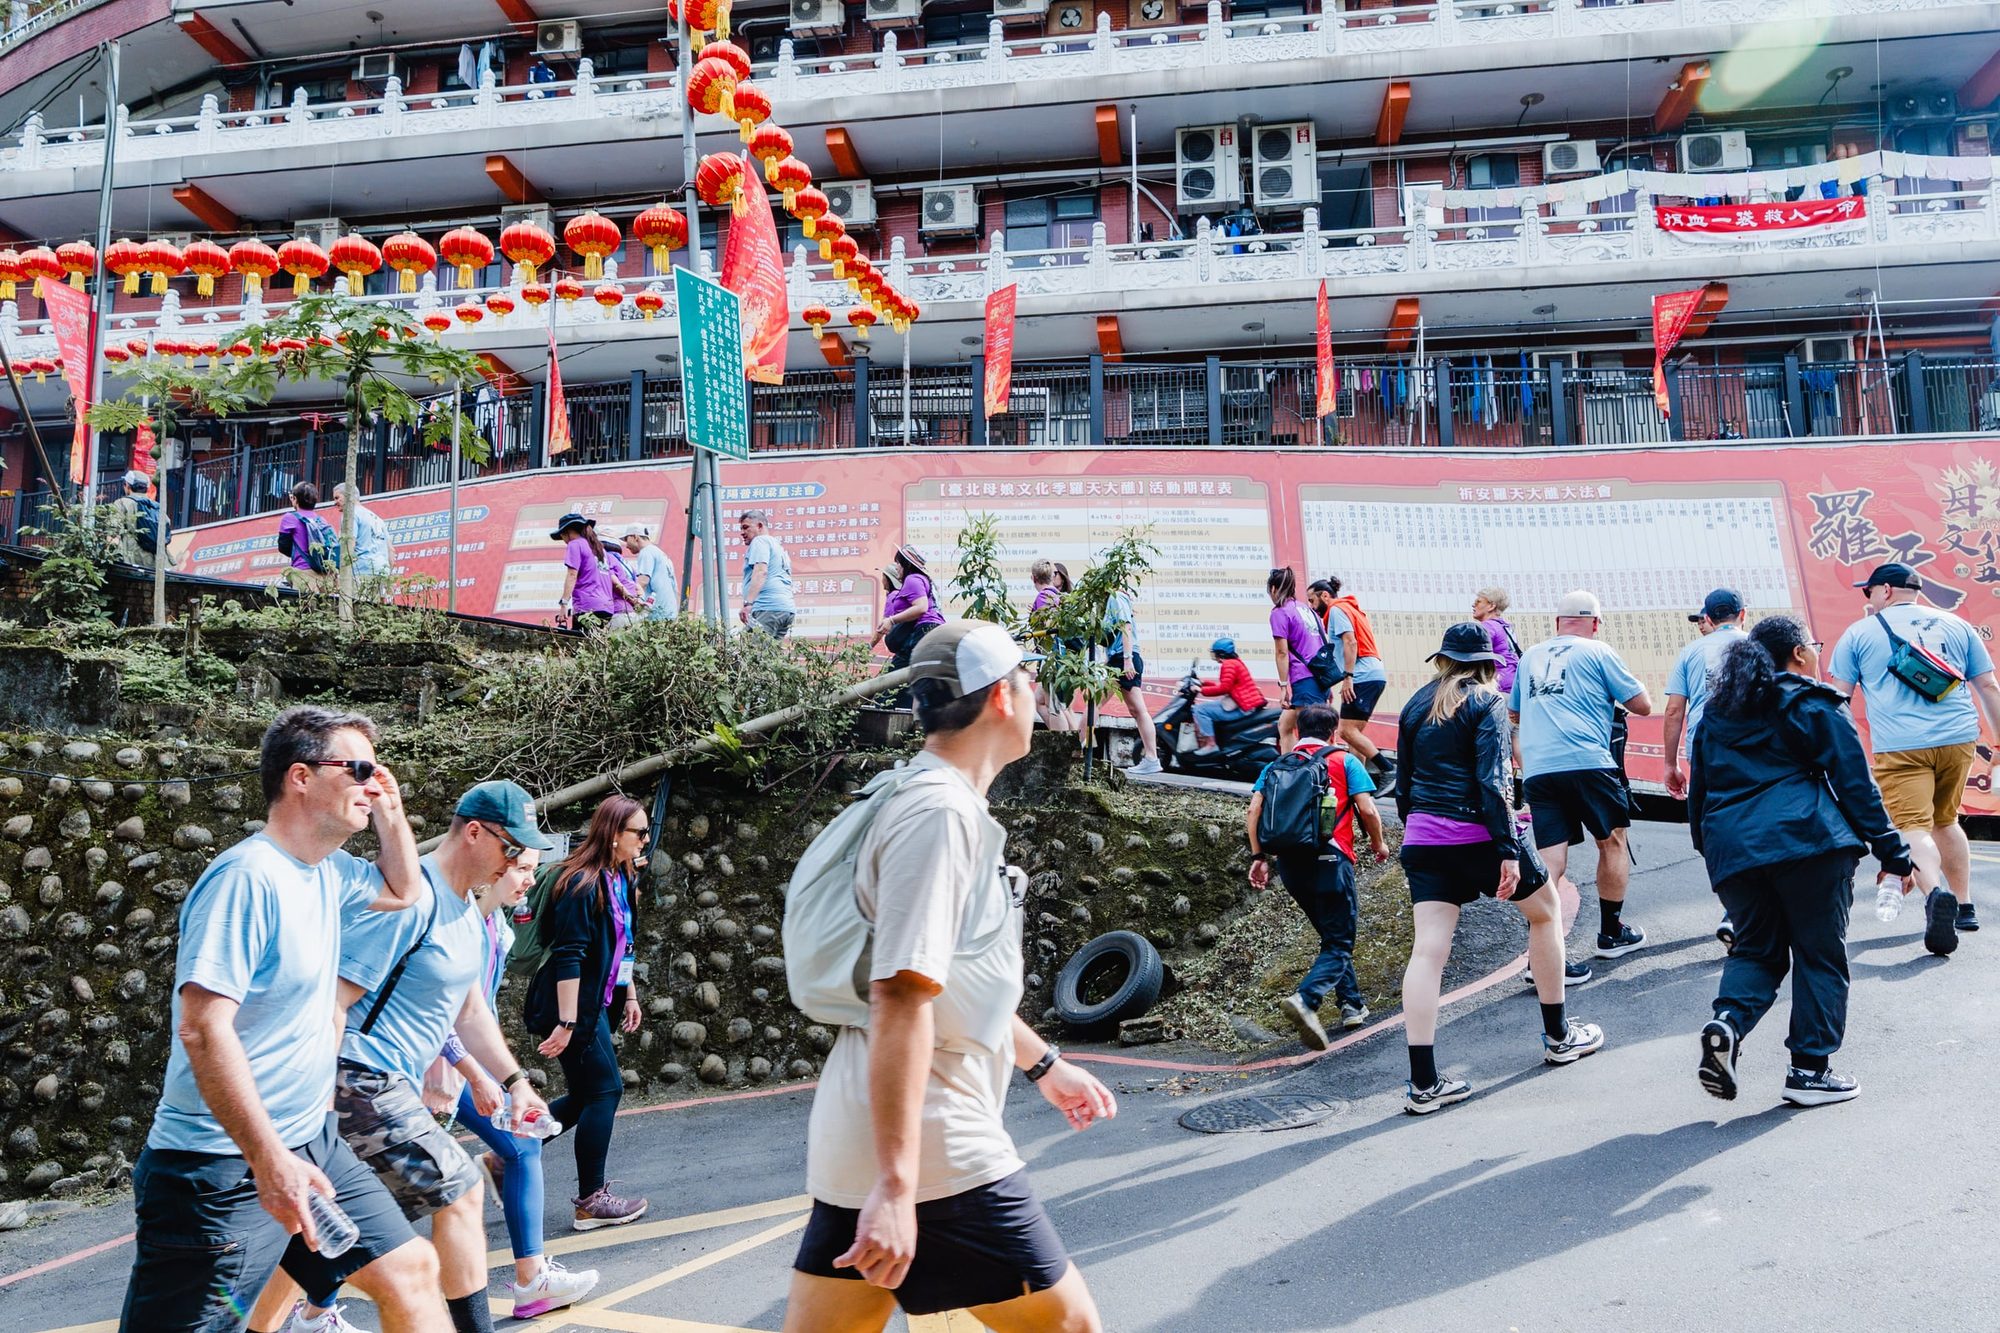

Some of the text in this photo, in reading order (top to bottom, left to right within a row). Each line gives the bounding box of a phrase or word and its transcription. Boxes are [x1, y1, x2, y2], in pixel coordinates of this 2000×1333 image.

[1664, 200, 1857, 228] 捐血一袋 救人一命
